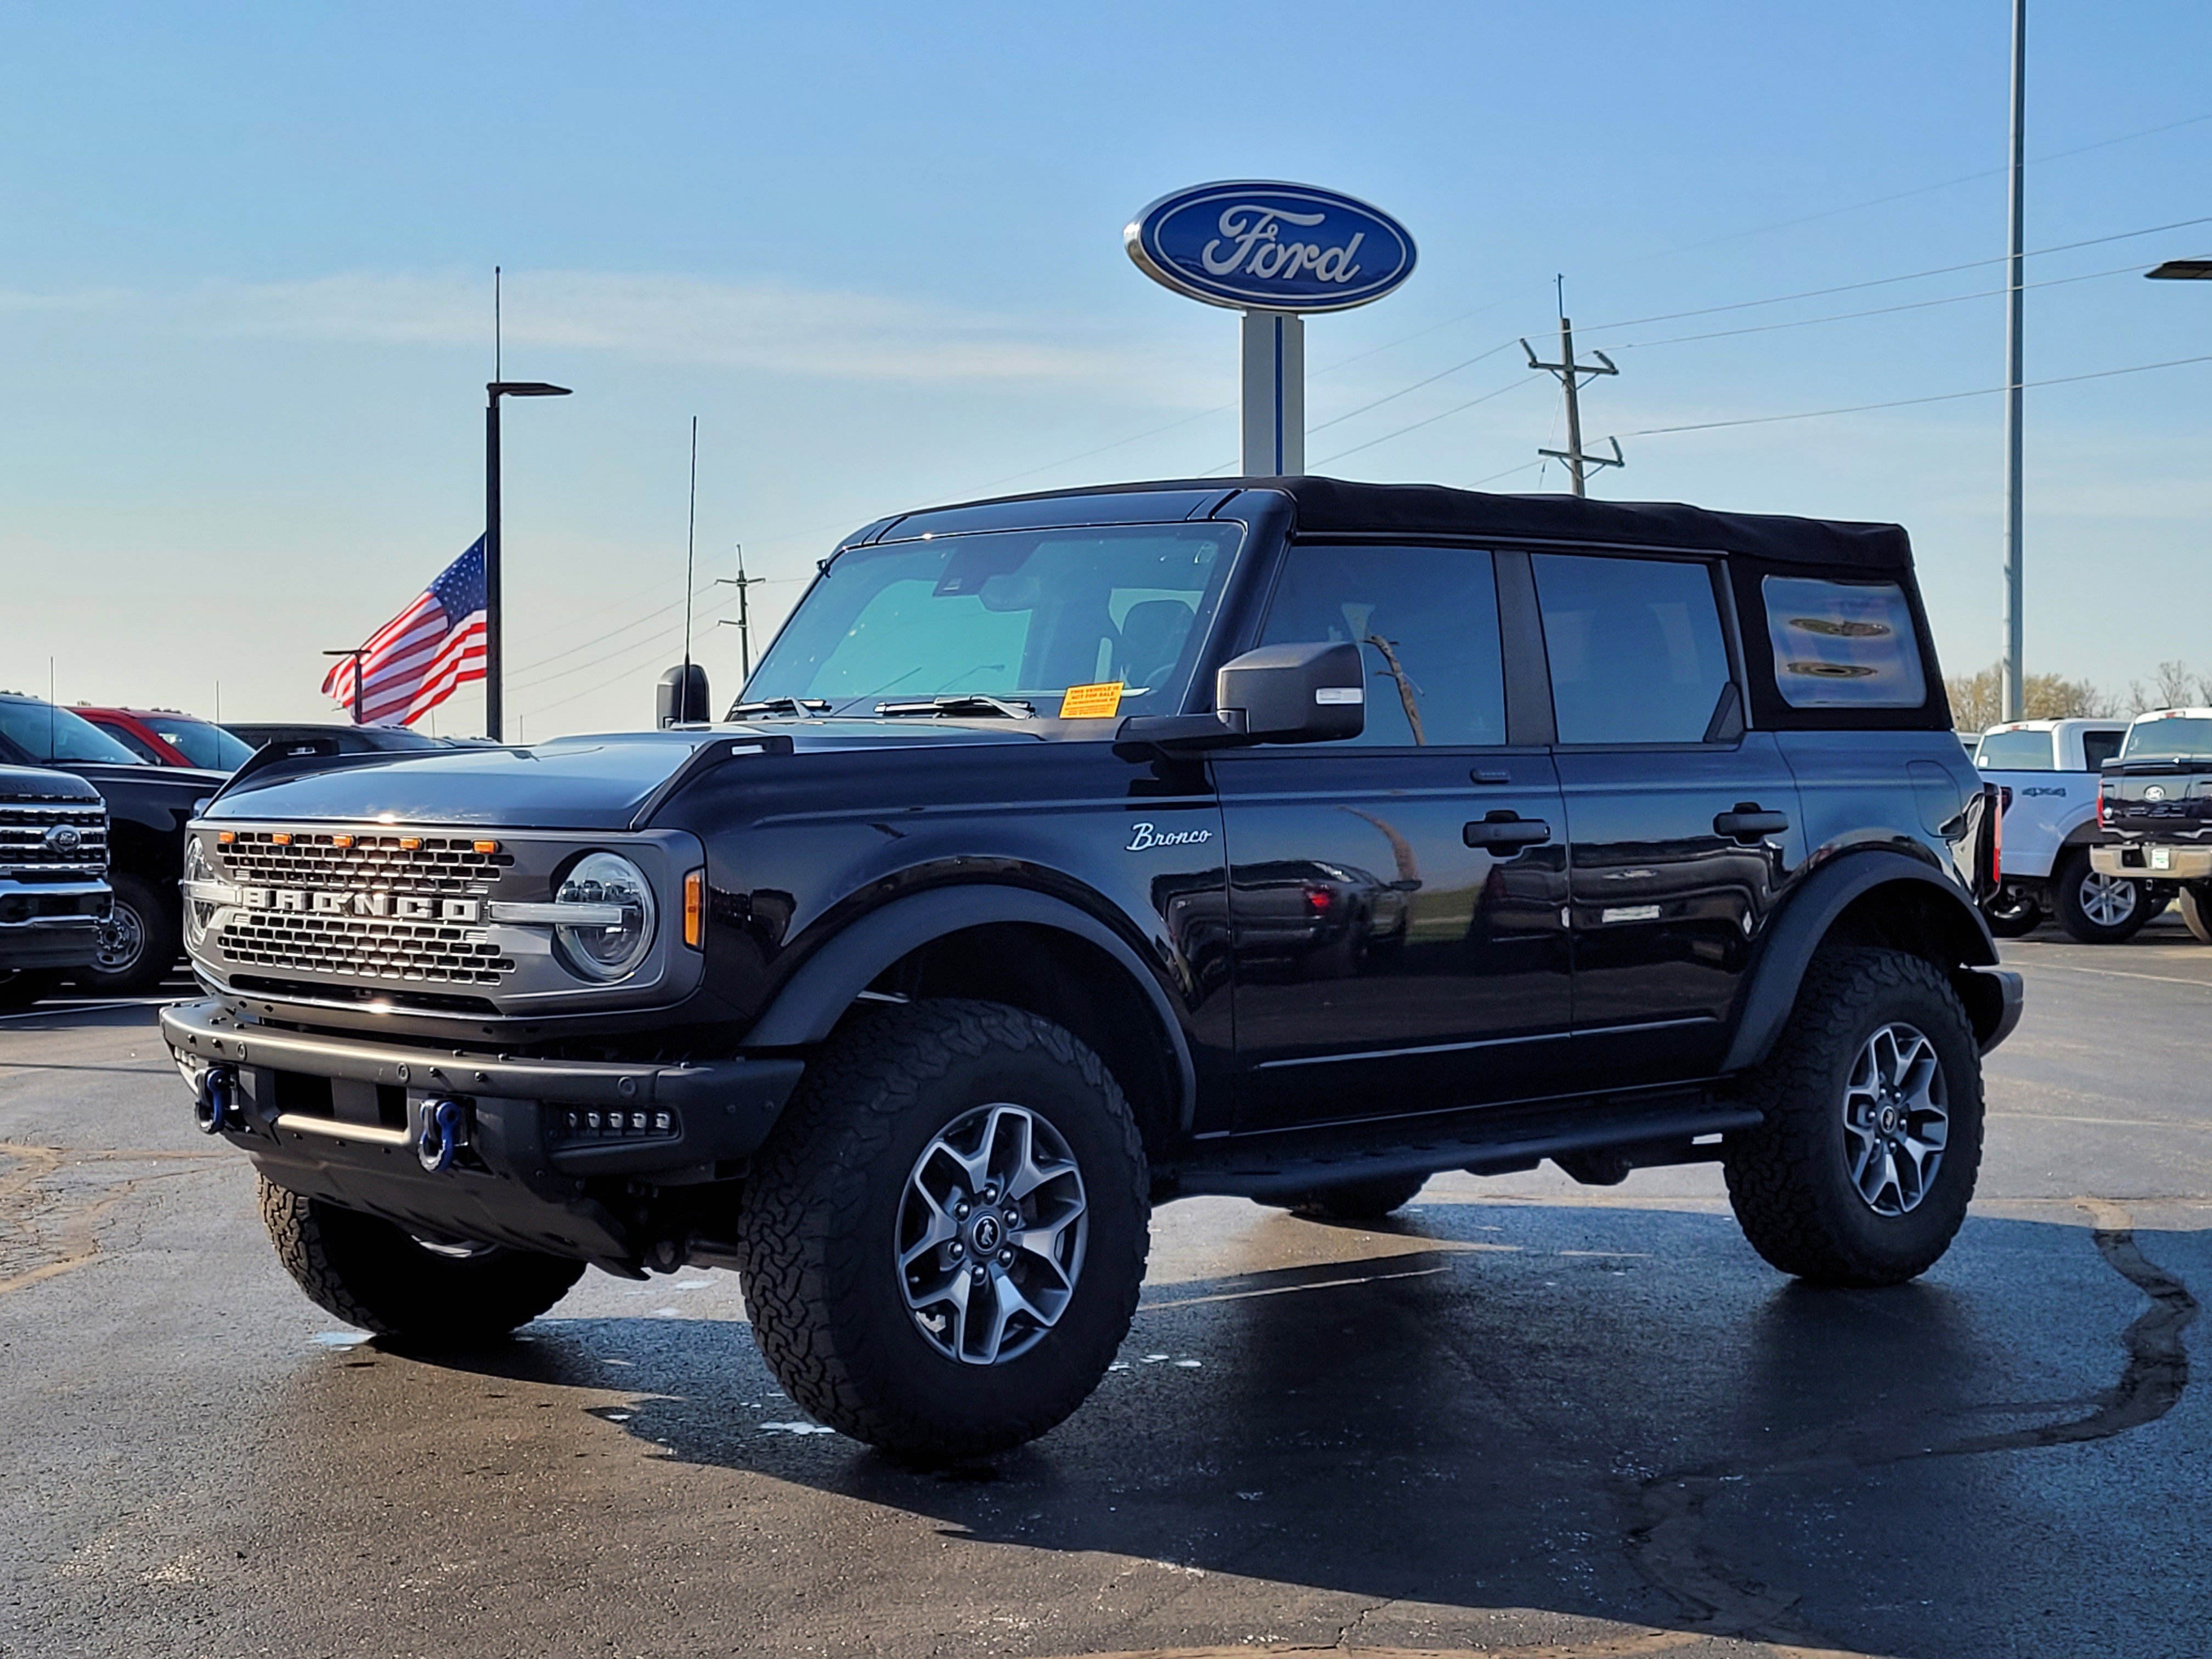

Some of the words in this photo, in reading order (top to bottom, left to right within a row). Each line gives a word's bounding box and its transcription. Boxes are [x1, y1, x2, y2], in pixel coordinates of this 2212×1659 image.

[1201, 205, 1364, 283] Ford
[1126, 822, 1212, 850] Bronco
[243, 887, 479, 921] BRONCO
